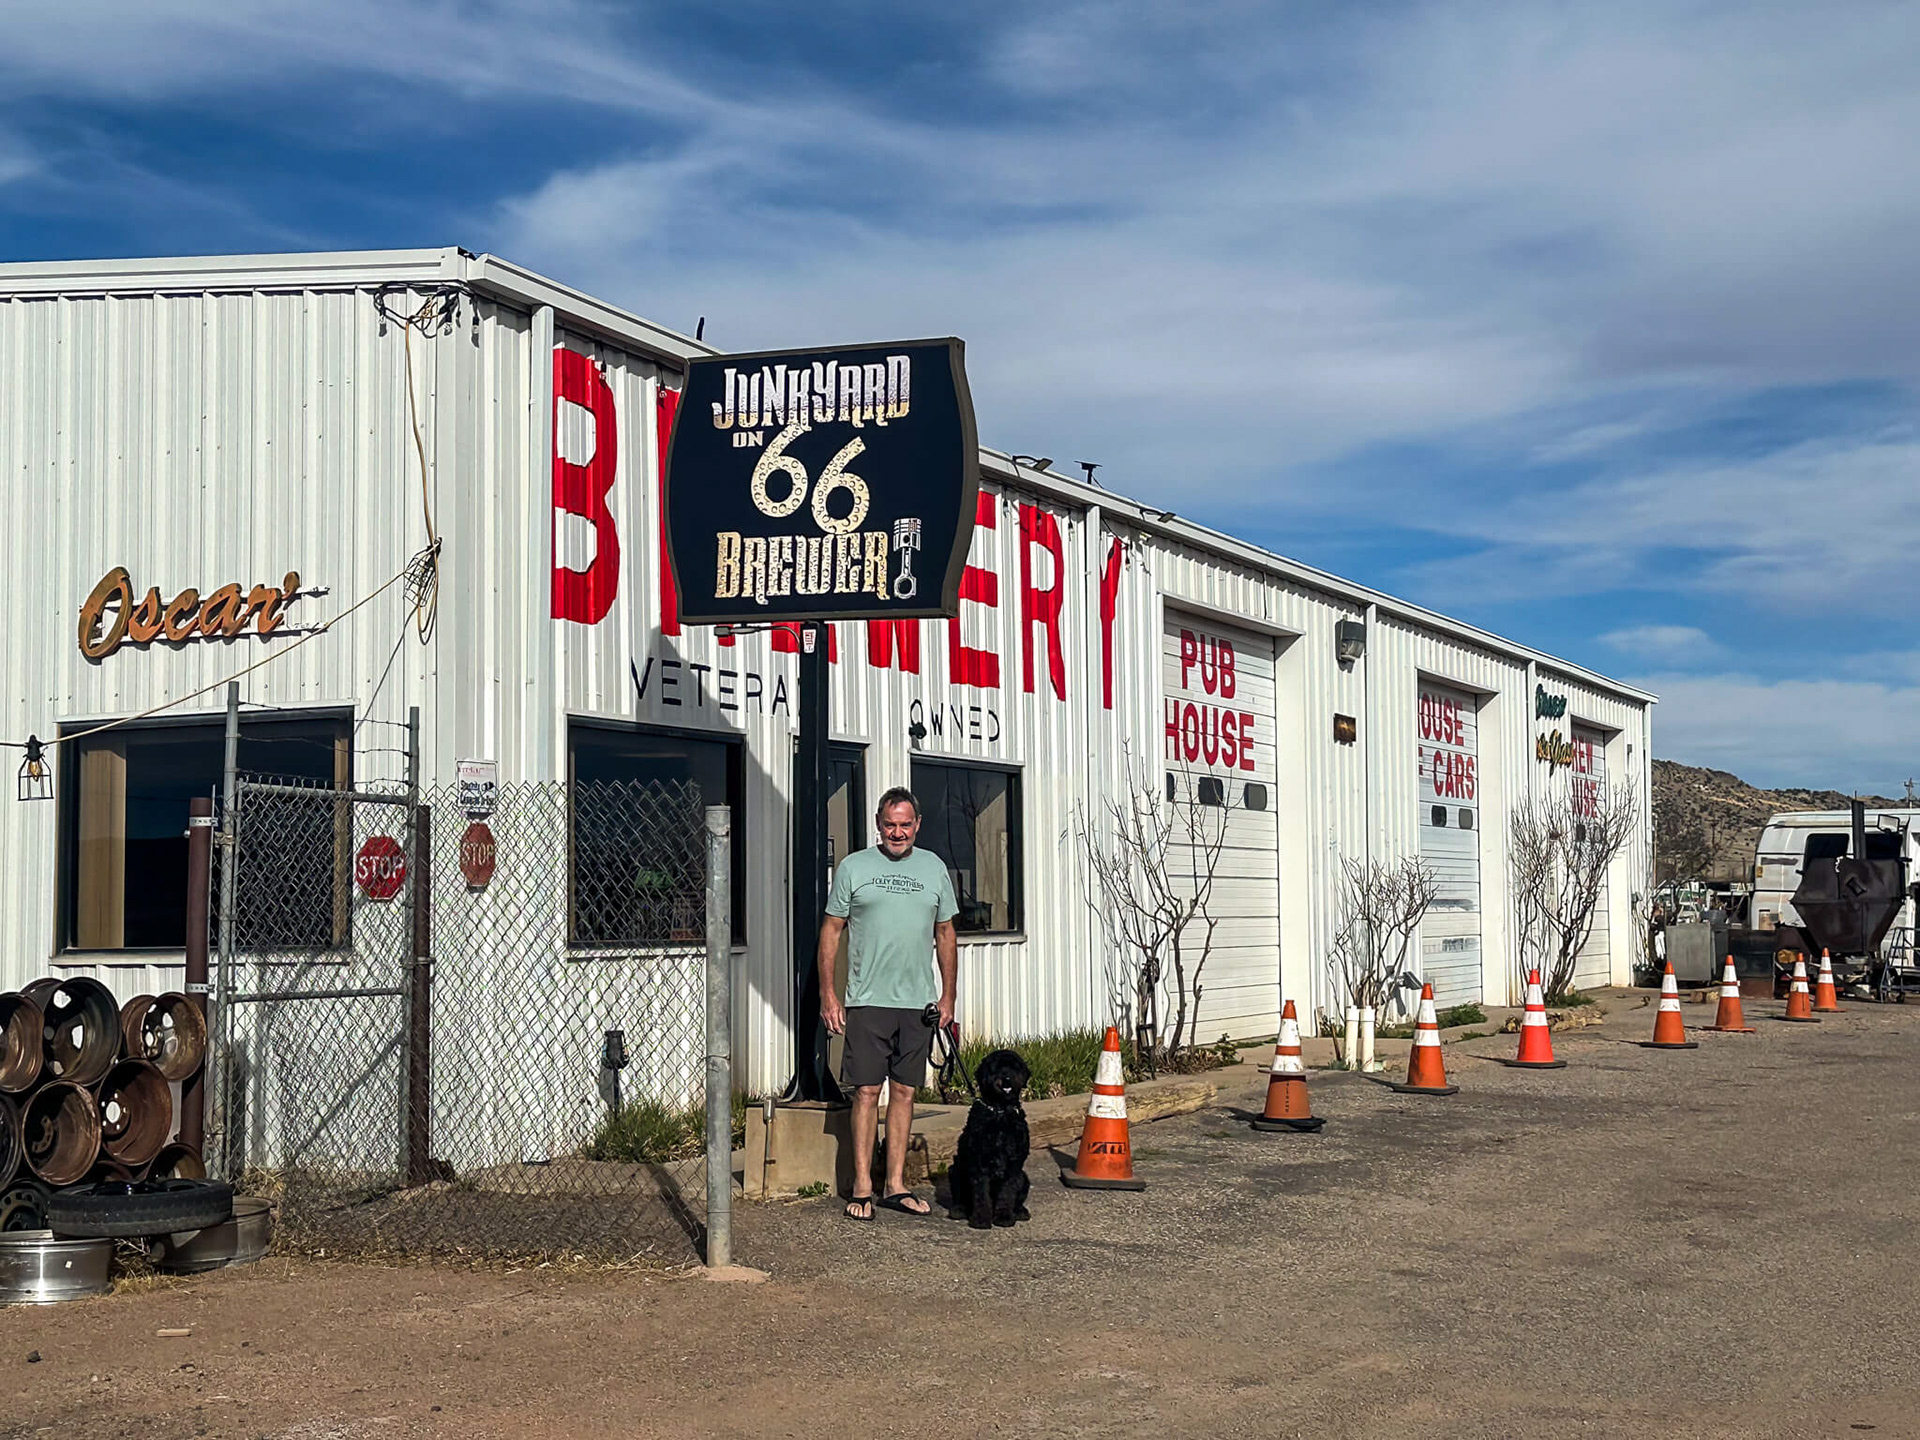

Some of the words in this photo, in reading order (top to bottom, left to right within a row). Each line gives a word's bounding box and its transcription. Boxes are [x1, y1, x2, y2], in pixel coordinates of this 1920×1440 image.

[711, 355, 912, 431] JUNKYARD
[732, 430, 764, 448] ON
[750, 423, 870, 534] 66
[550, 347, 1124, 711] BERY
[631, 656, 801, 719] VETERA
[909, 698, 1001, 742] OWNED
[1180, 628, 1236, 700] PUB
[1164, 697, 1255, 772] HOUSE
[1417, 691, 1465, 747] OUSE
[1432, 749, 1475, 801] CARS
[357, 855, 405, 880] STOP
[460, 841, 496, 867] STOP
